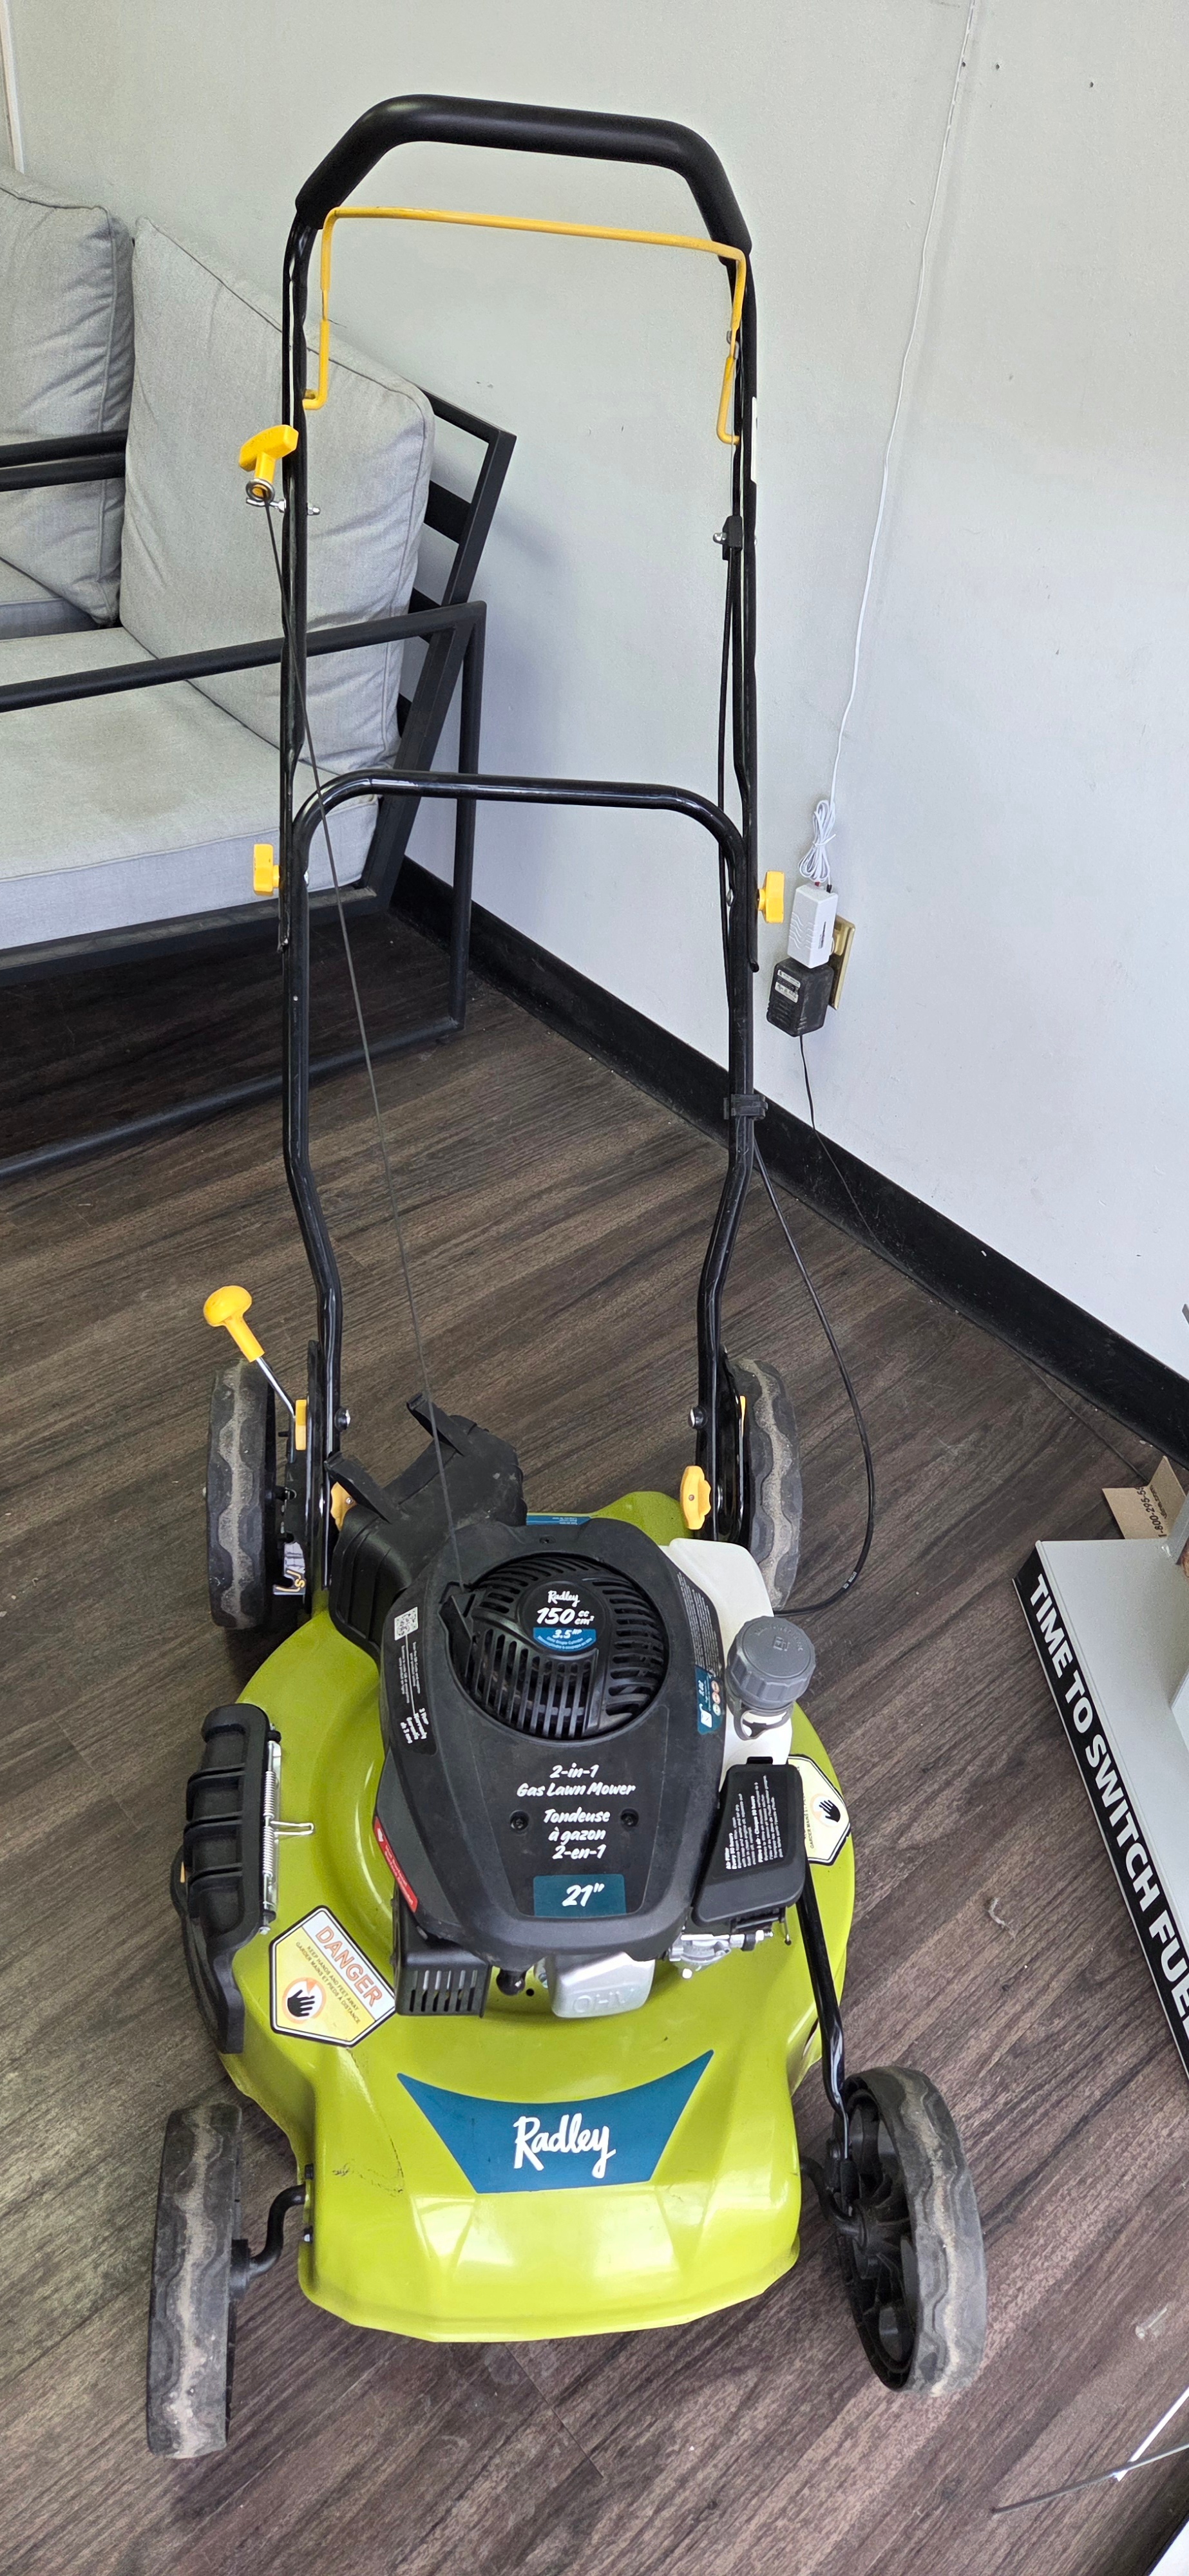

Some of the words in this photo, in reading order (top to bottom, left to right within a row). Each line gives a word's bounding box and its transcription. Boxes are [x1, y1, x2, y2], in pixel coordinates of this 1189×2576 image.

[547, 1590, 580, 1607] Radley
[537, 1607, 575, 1625] 150
[549, 1762, 600, 1779] 2-in-1
[517, 1783, 546, 1797] Gas
[546, 1782, 587, 1797] Lawn
[586, 1781, 636, 1795] Mower
[543, 1806, 611, 1823] Tondeuse
[1030, 1573, 1073, 1678] TIME
[1065, 1669, 1093, 1734] TO
[1085, 1734, 1161, 1913] SWITCH
[1148, 1909, 1189, 2040] FUE
[548, 1826, 560, 1841] à
[560, 1829, 606, 1846] gazon
[552, 1844, 607, 1860] 2-en-1
[562, 1882, 605, 1907] 21"
[315, 1926, 383, 2007] DANGER
[296, 1942, 311, 1962] GARDER
[311, 1961, 323, 1976] MAINS
[328, 1980, 339, 1996] PIEDS
[341, 1999, 361, 2025] DISTANCE
[307, 1946, 318, 1959] KEEP
[317, 1958, 330, 1975] HANDS
[329, 1974, 339, 1986] AND
[338, 1984, 348, 1997] FEET
[347, 1996, 359, 2011] AWAY
[513, 2112, 616, 2179] Radley
